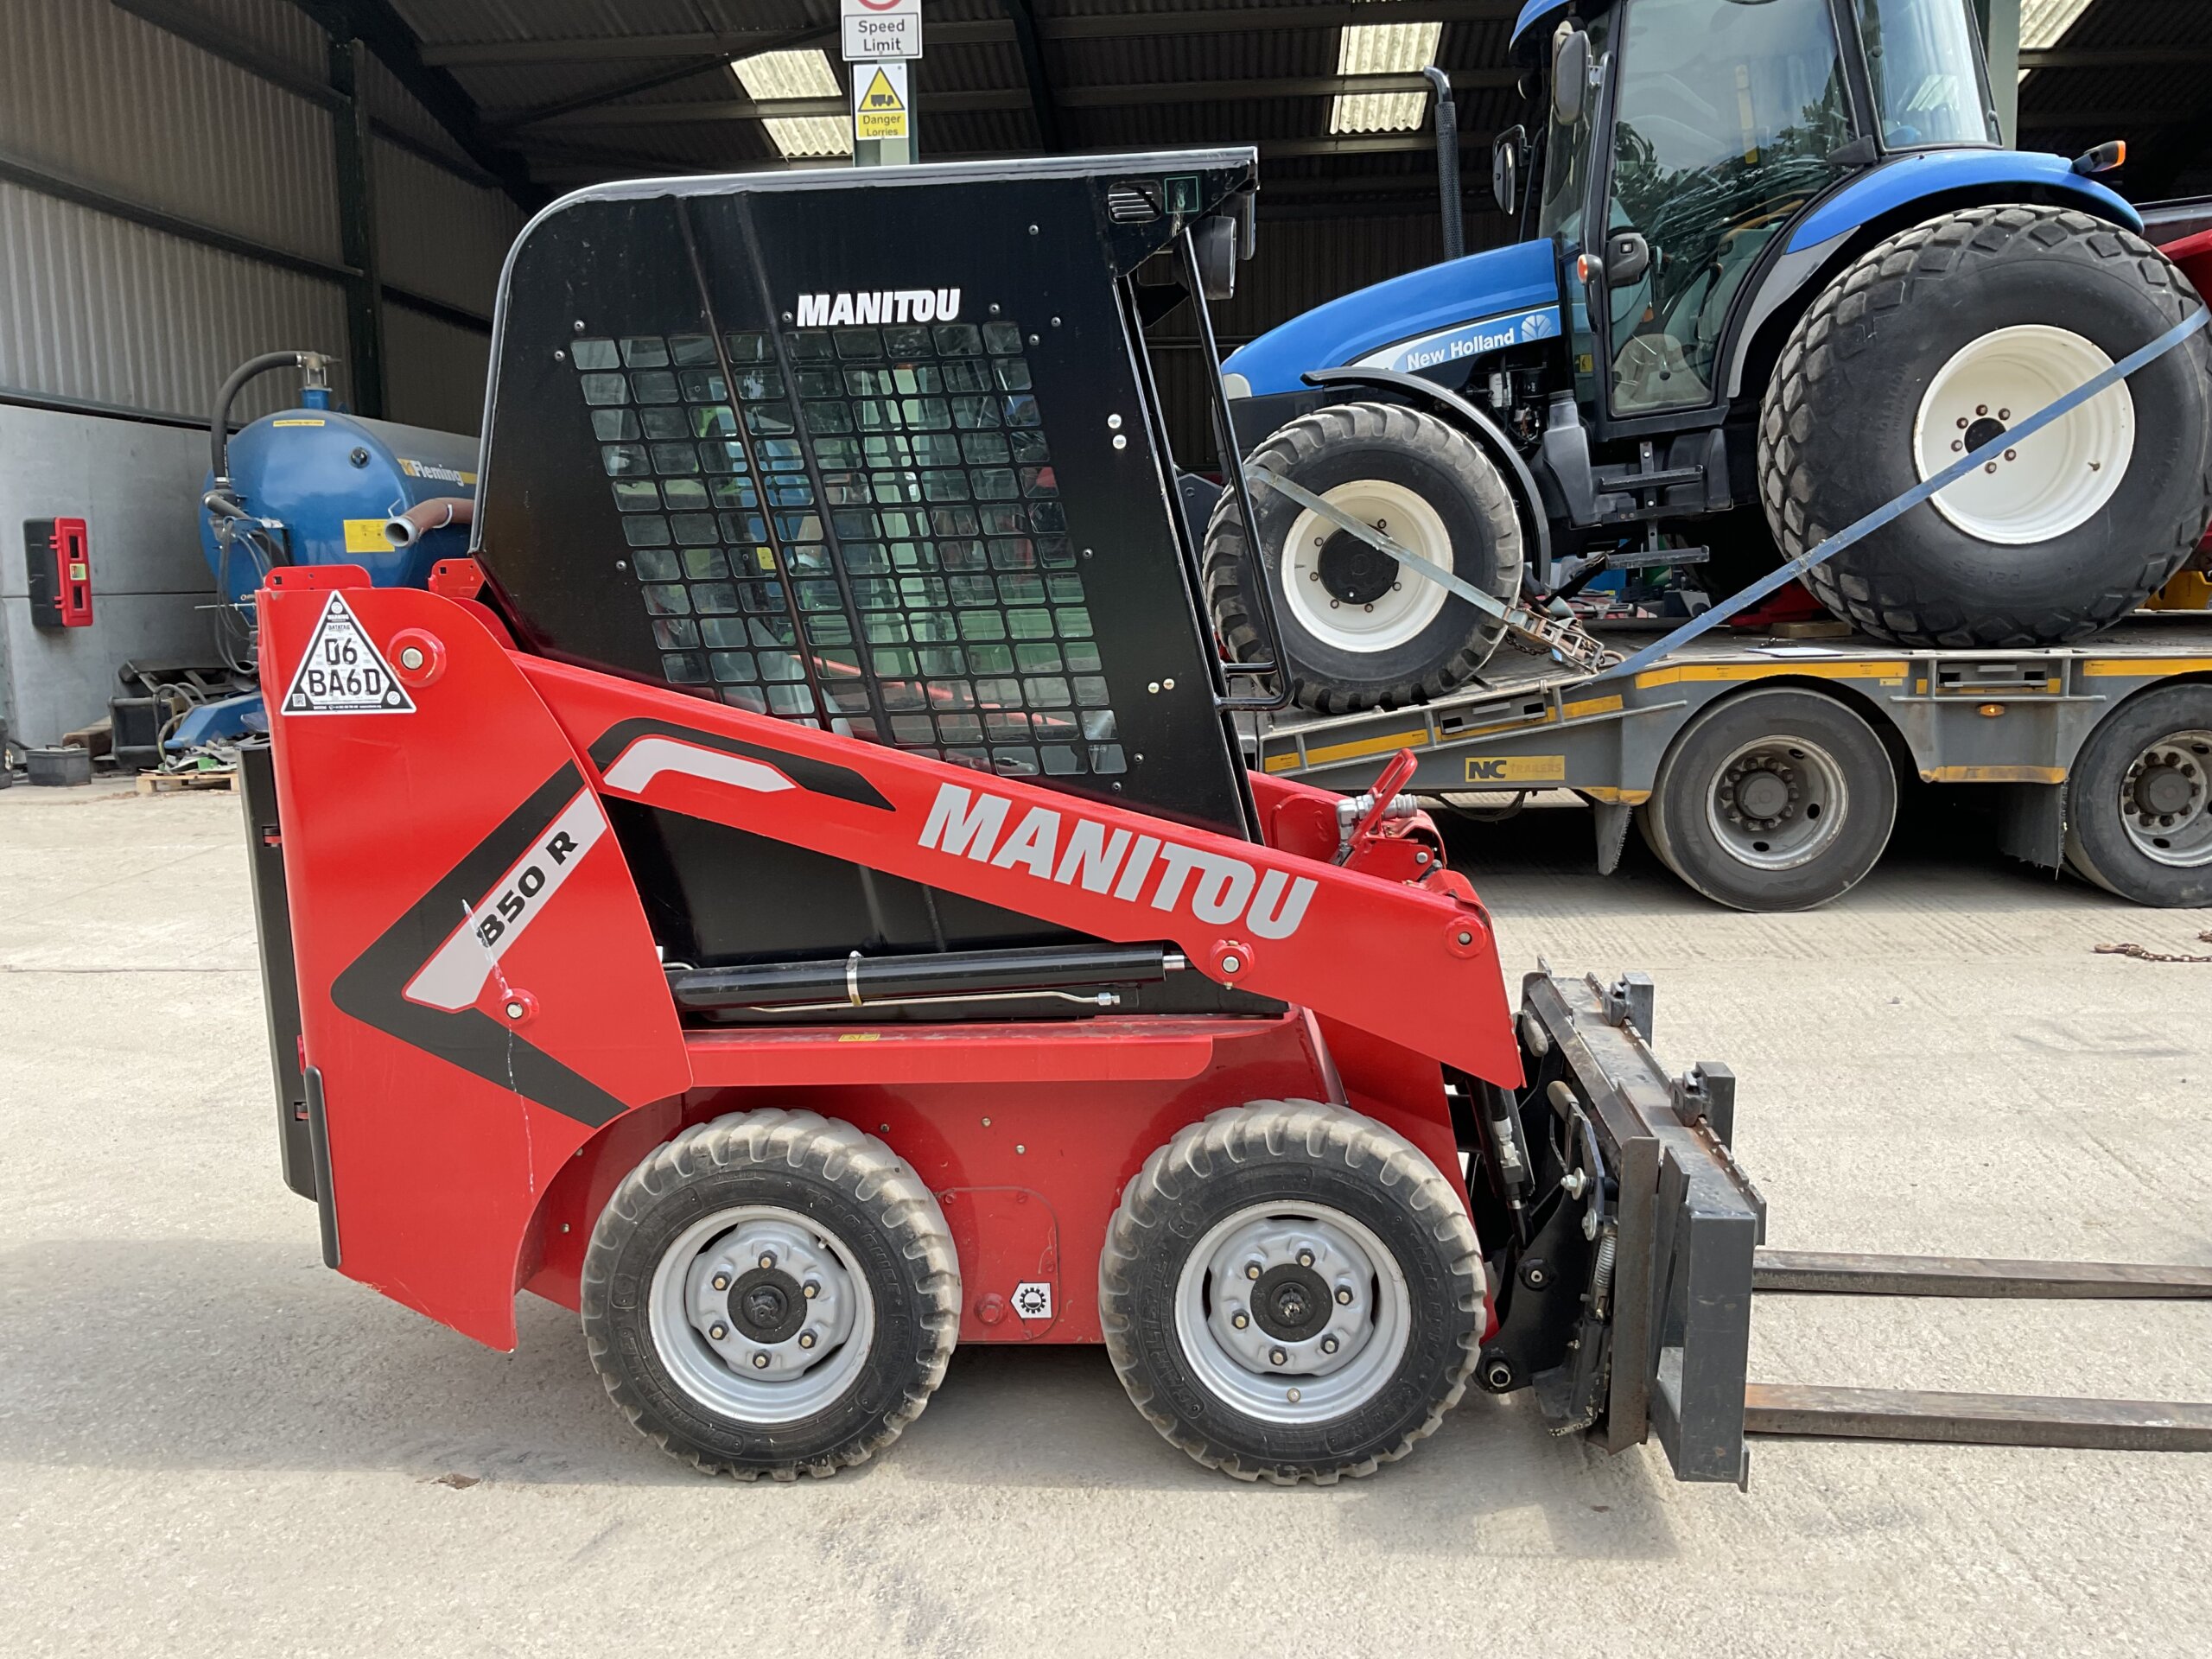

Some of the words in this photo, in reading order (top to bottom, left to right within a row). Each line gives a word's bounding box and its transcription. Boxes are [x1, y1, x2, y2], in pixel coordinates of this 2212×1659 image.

[858, 19, 905, 35] Speed
[863, 38, 901, 52] Limit
[863, 115, 901, 126] Danger
[866, 128, 899, 137] Lorries
[797, 288, 961, 327] MANITOU
[1406, 348, 1446, 371] New
[1450, 327, 1515, 359] Holland
[410, 460, 464, 486] Fleming
[308, 669, 382, 696] BA6D
[1468, 760, 1507, 779] NC
[546, 831, 579, 866] R
[917, 782, 1319, 940] MANITOU
